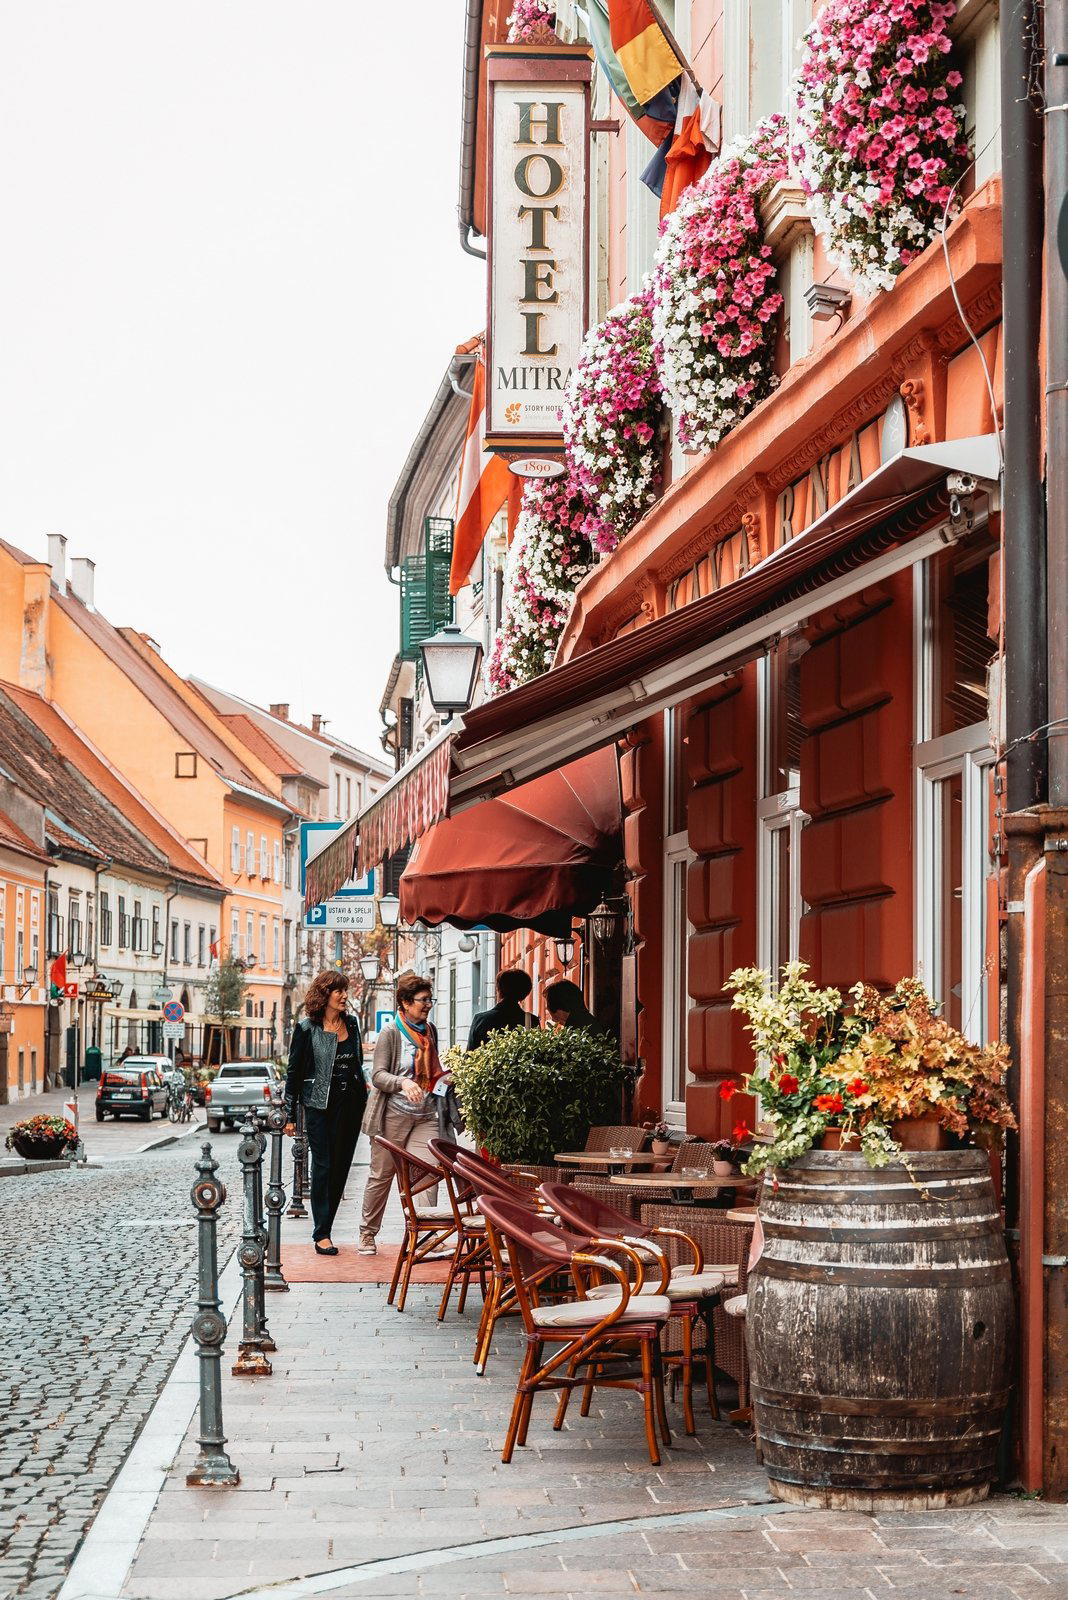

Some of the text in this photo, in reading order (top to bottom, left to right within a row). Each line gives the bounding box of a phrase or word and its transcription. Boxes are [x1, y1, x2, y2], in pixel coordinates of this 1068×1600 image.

[513, 101, 566, 357] HOTEL
[525, 404, 544, 412] STORY
[524, 461, 551, 474] 1890
[311, 907, 322, 922] P
